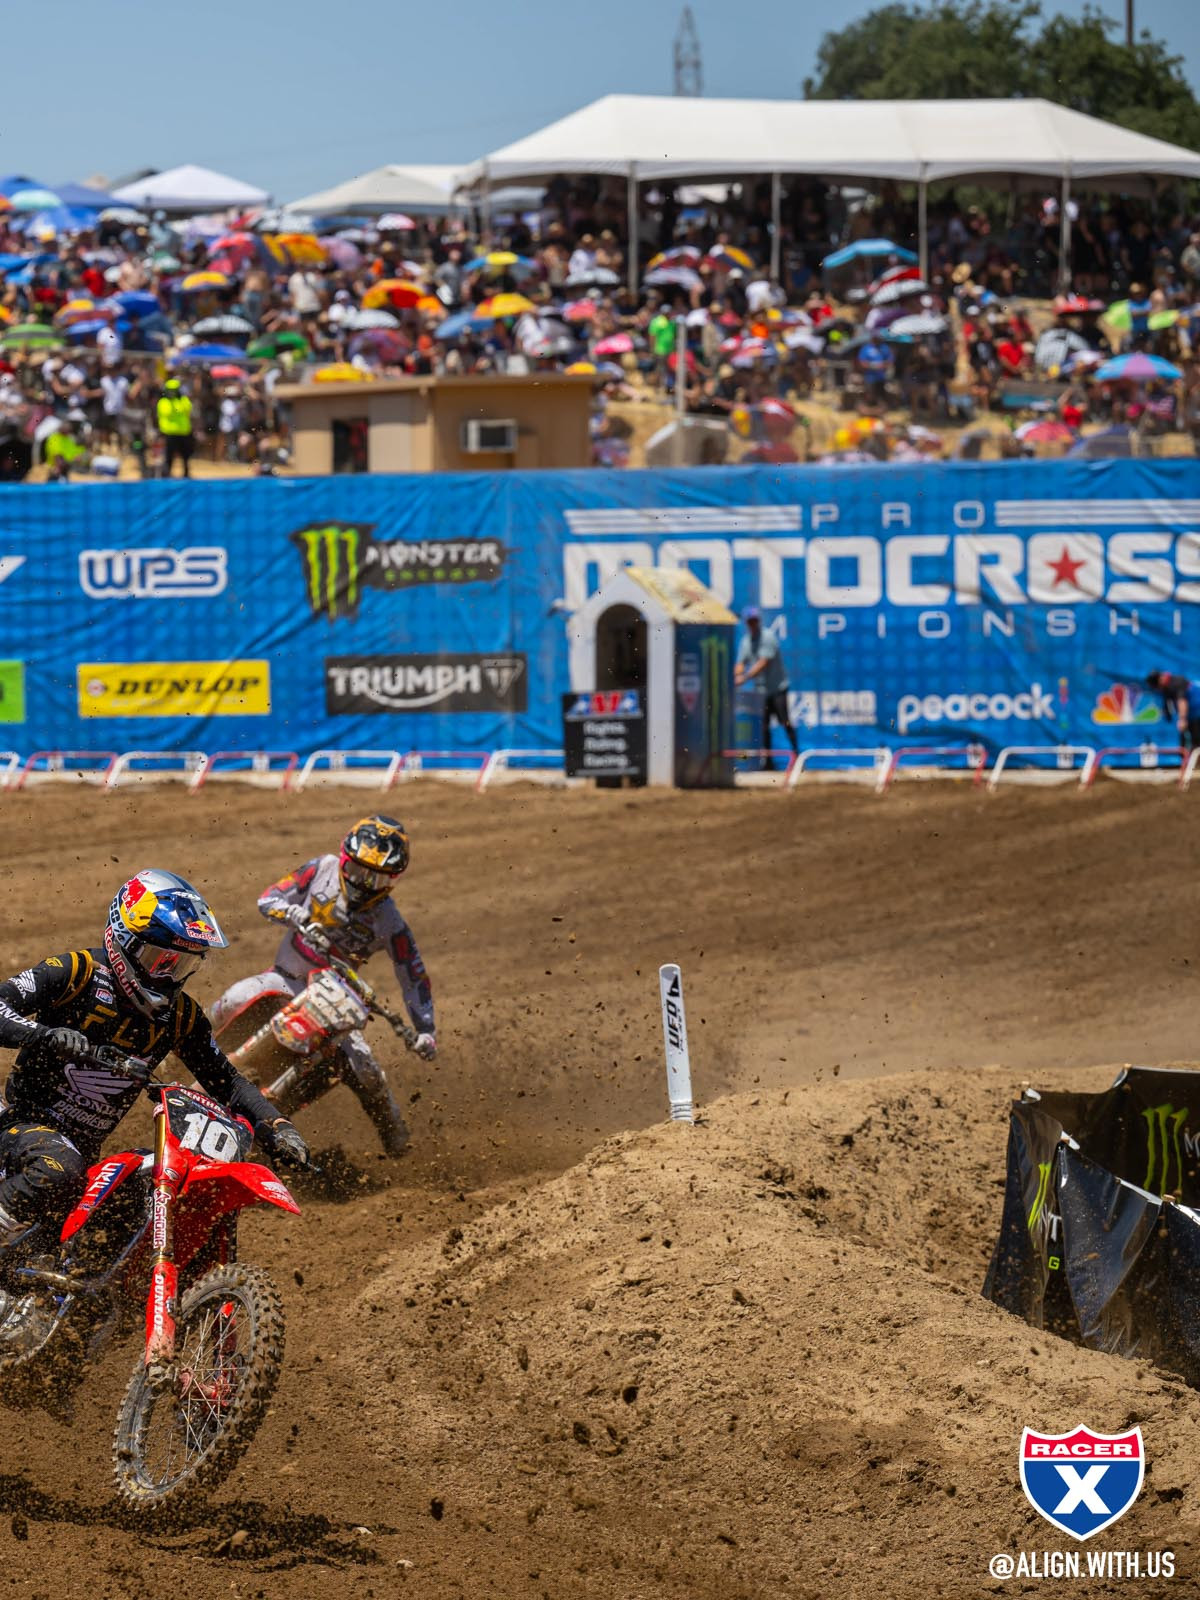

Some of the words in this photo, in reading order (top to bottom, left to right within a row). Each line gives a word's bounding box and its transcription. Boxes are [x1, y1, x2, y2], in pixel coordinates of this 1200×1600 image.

[81, 549, 226, 596] WPS
[365, 541, 501, 568] MONSTER
[116, 676, 261, 695] DUNLOP
[328, 664, 482, 699] TRIUMPH
[897, 683, 1056, 735] peacock
[106, 925, 121, 964] Red
[113, 960, 140, 998] Bull
[81, 1004, 166, 1054] FLY
[666, 998, 680, 1050] UFO
[179, 1112, 239, 1163] 10
[154, 1205, 167, 1248] SHOWA
[153, 1273, 166, 1337] DUNLOP
